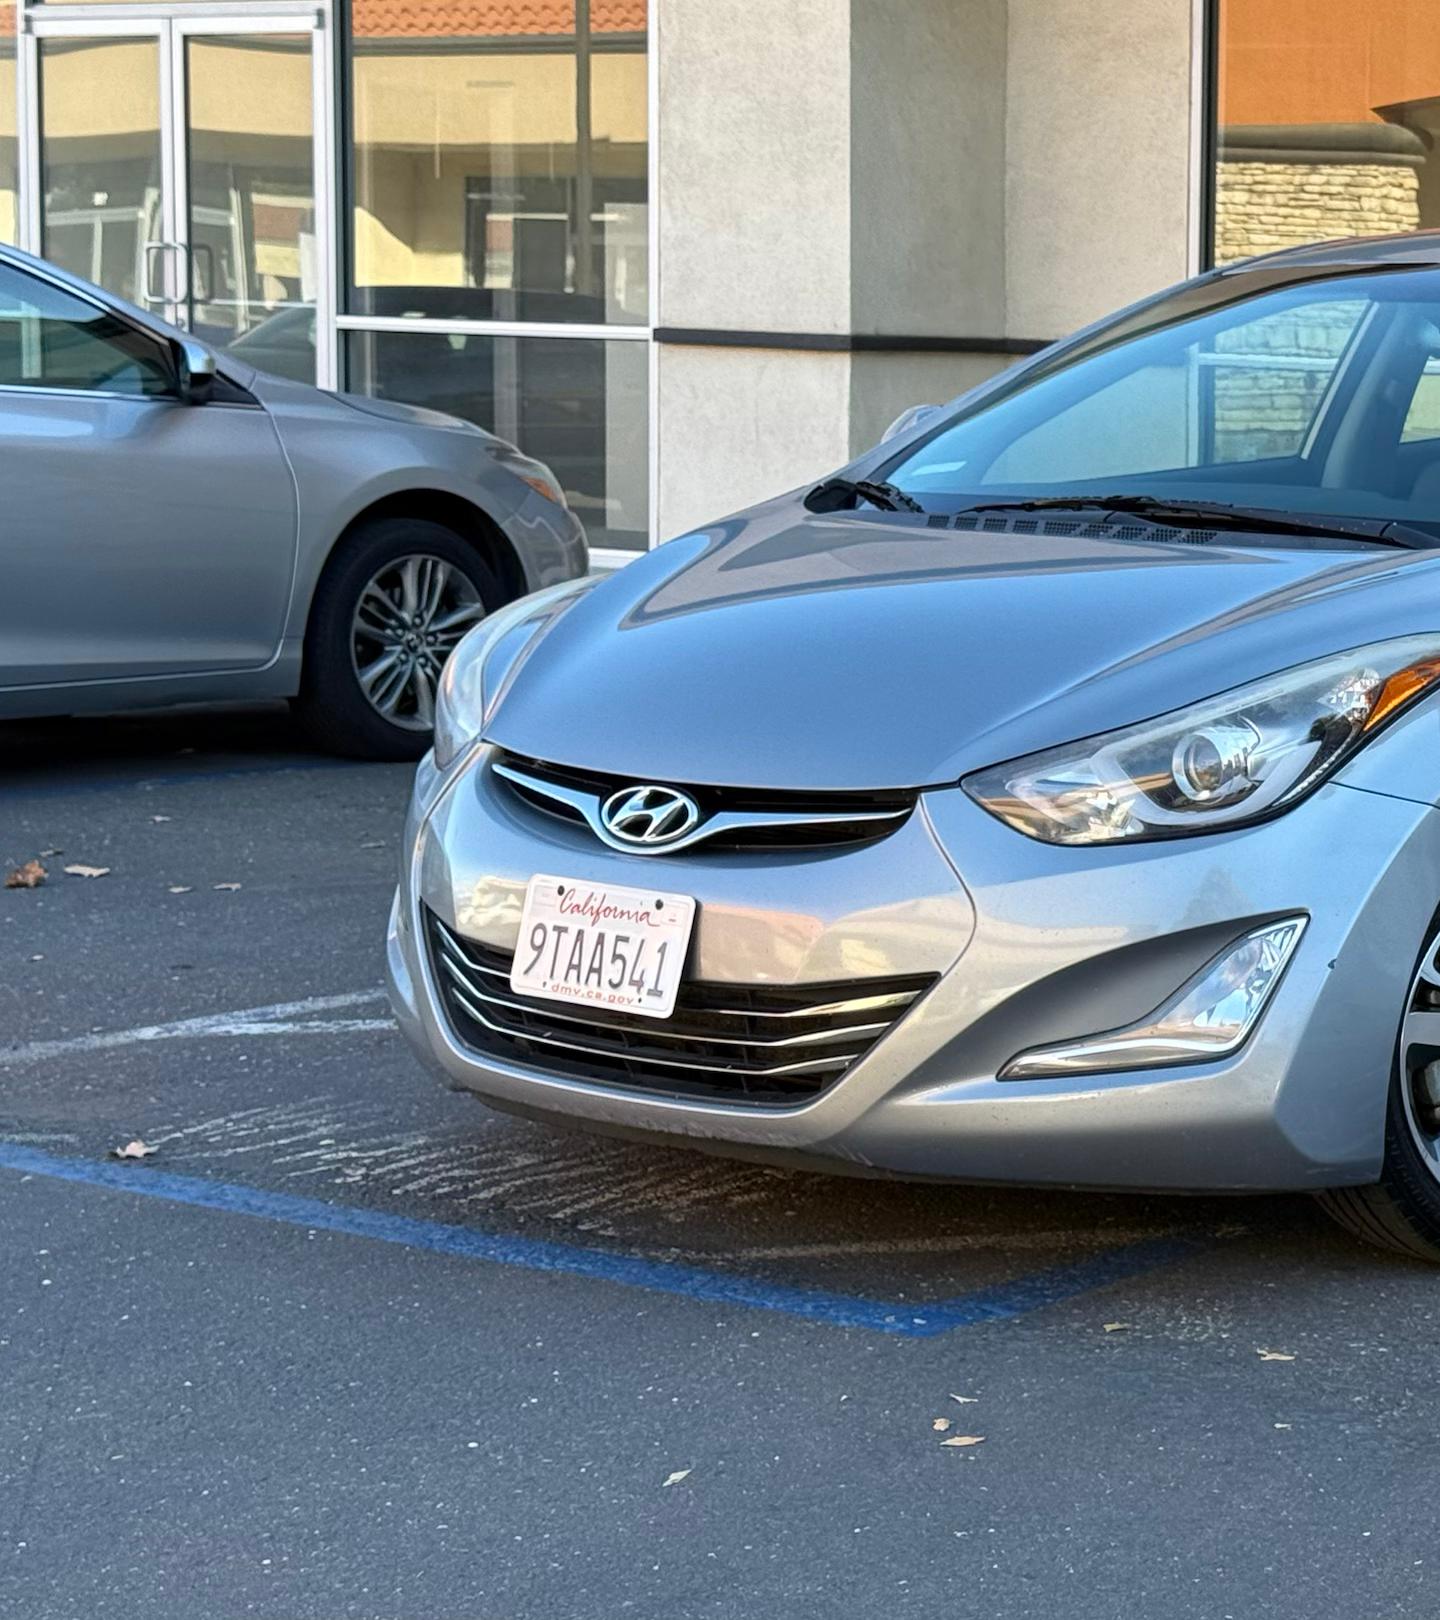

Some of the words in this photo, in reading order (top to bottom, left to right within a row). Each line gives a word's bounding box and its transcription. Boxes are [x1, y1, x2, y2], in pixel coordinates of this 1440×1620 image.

[559, 888, 661, 927] California
[523, 922, 668, 998] 9TAA541
[551, 983, 635, 1005] dmv.ca.gov
